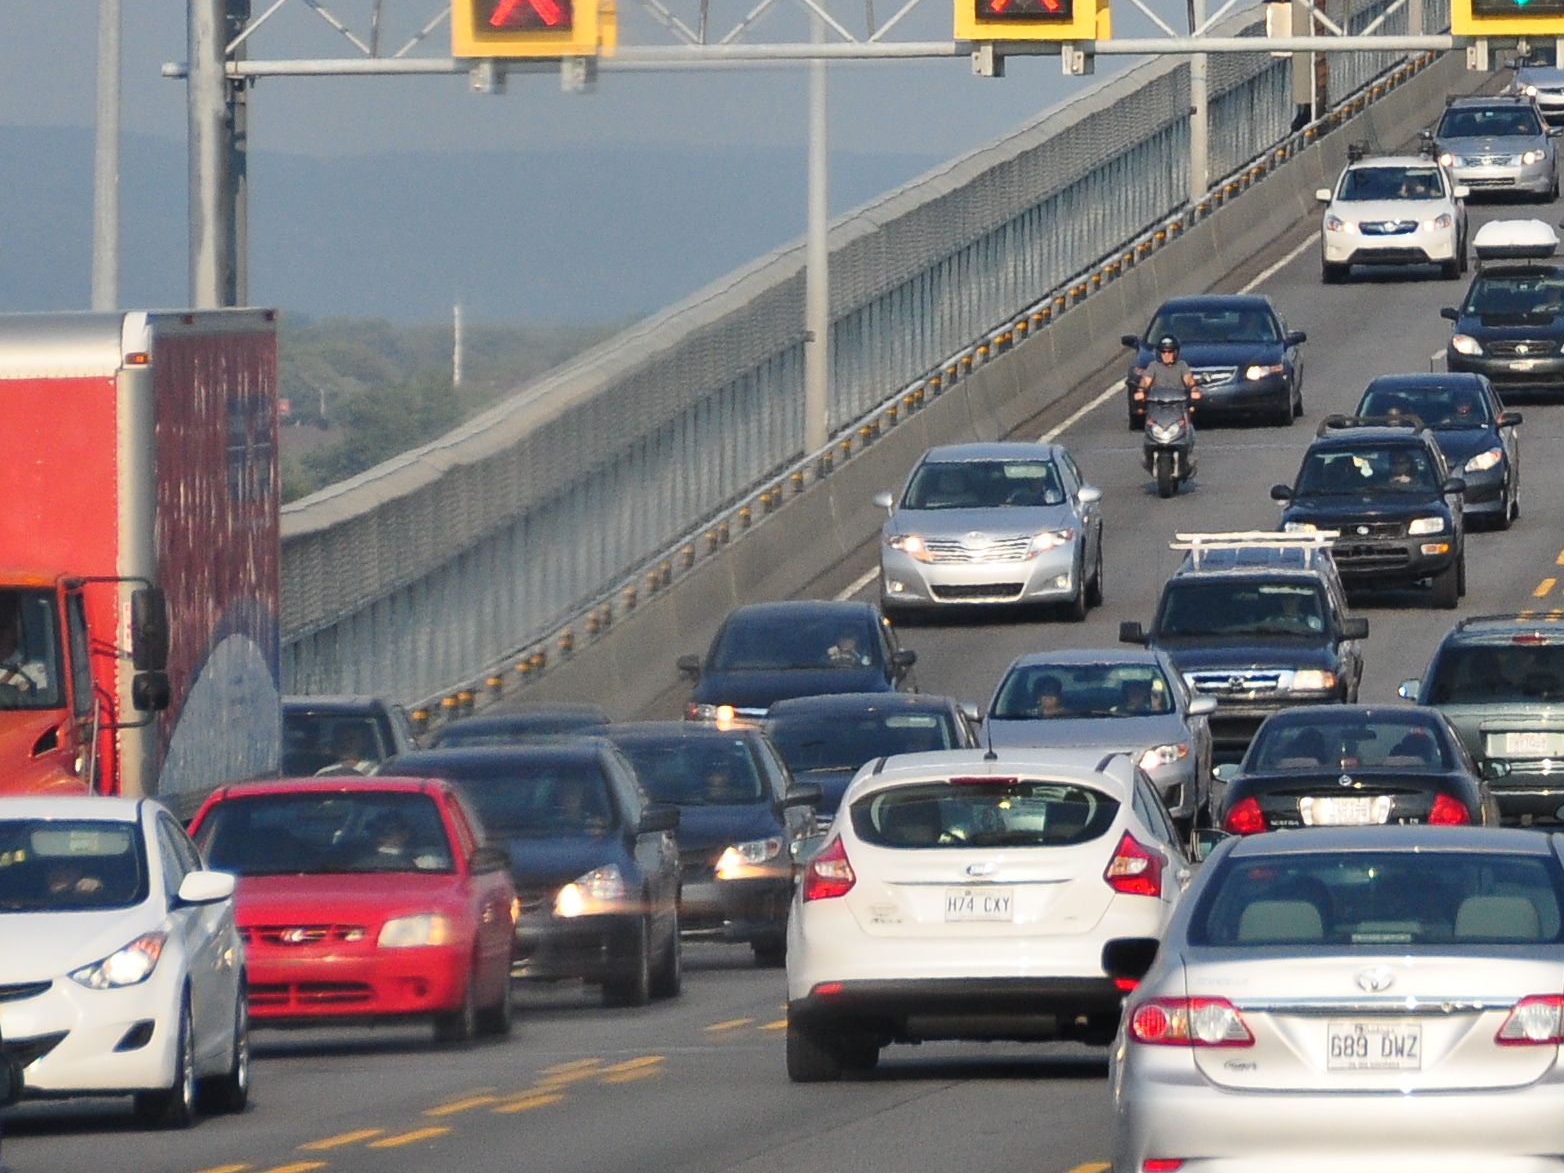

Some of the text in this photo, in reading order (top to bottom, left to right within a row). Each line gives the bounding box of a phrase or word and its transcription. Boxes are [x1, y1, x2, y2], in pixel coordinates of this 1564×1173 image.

[948, 896, 1010, 913] H74 CXY
[1381, 1034, 1418, 1058] DWZ
